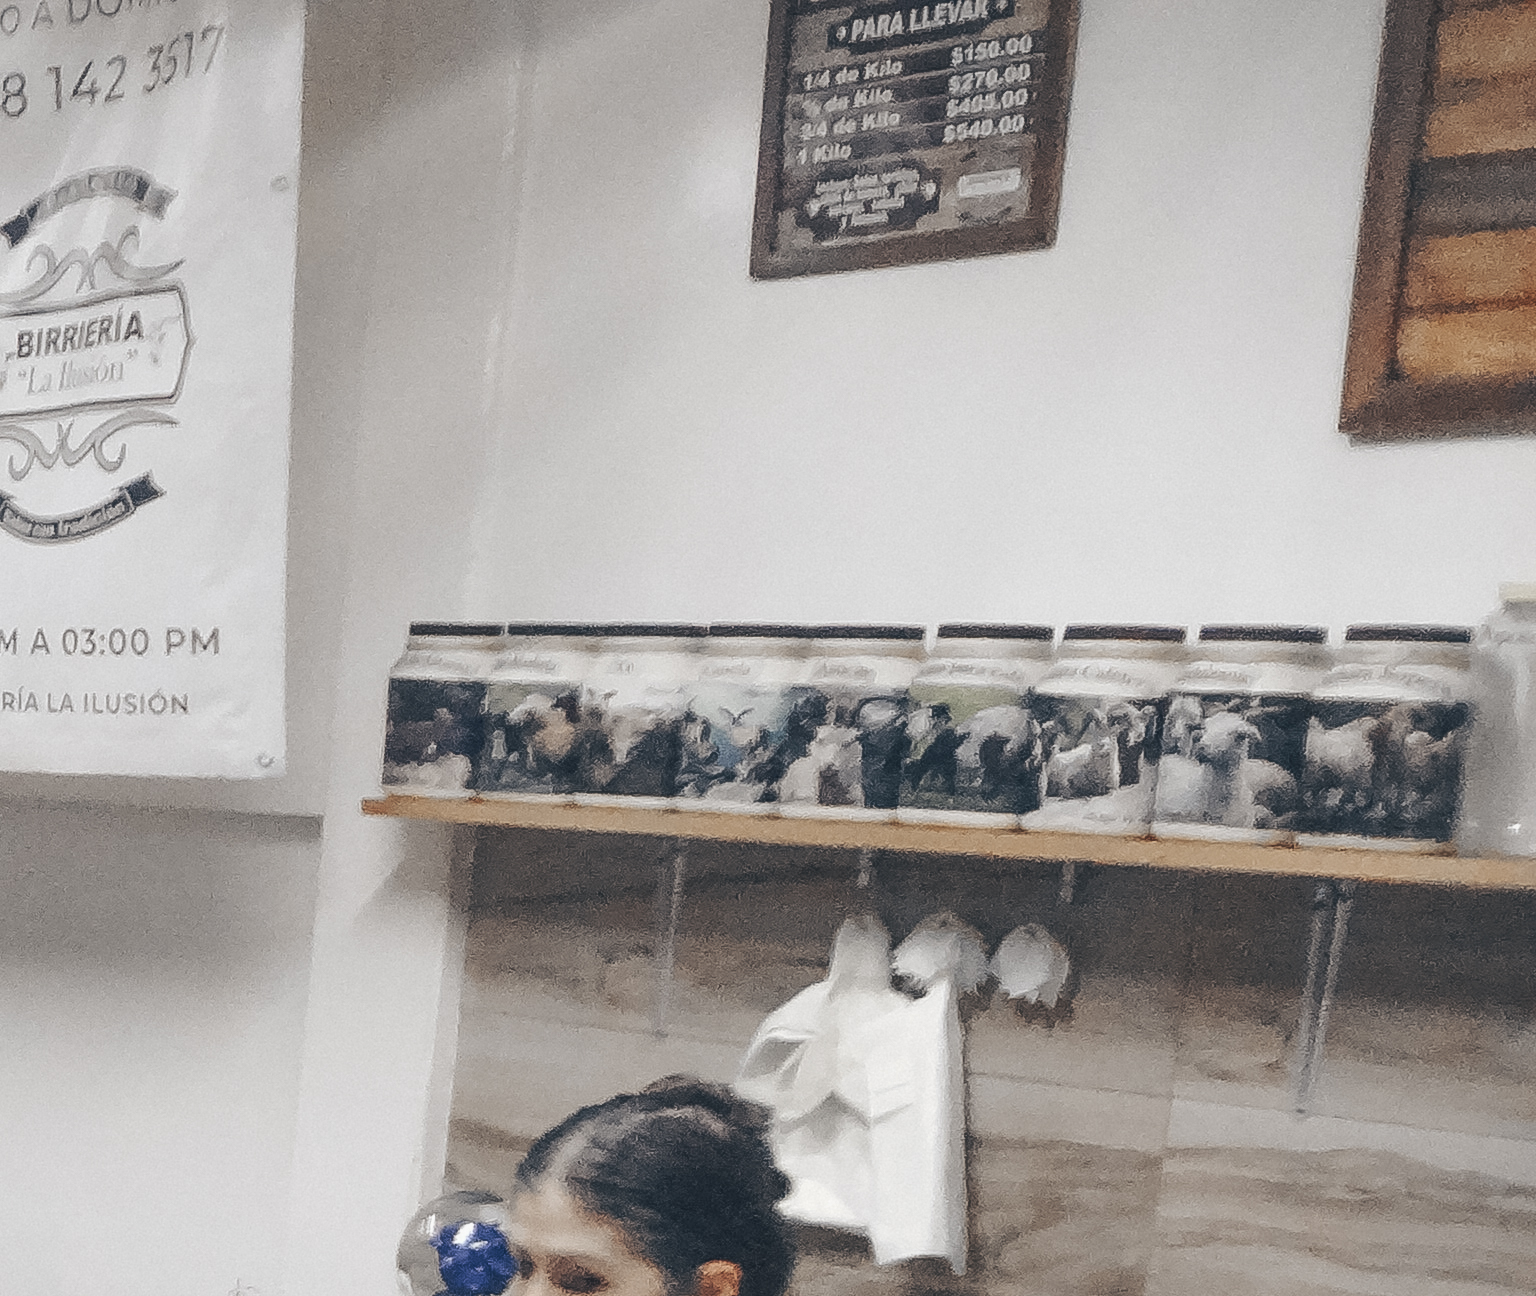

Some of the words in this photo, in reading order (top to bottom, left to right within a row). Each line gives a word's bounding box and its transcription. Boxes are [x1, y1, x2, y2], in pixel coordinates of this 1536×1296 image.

[31, 0, 54, 31] A
[849, 10, 904, 43] PARA
[47, 55, 128, 112] 142
[142, 23, 225, 93] 3517
[16, 303, 145, 360] BIRRIERÍA
[29, 626, 52, 657] A
[61, 626, 150, 657] 03:00
[164, 626, 221, 657] PM
[46, 692, 75, 714] LA
[83, 687, 190, 716] ILUSIÓN
